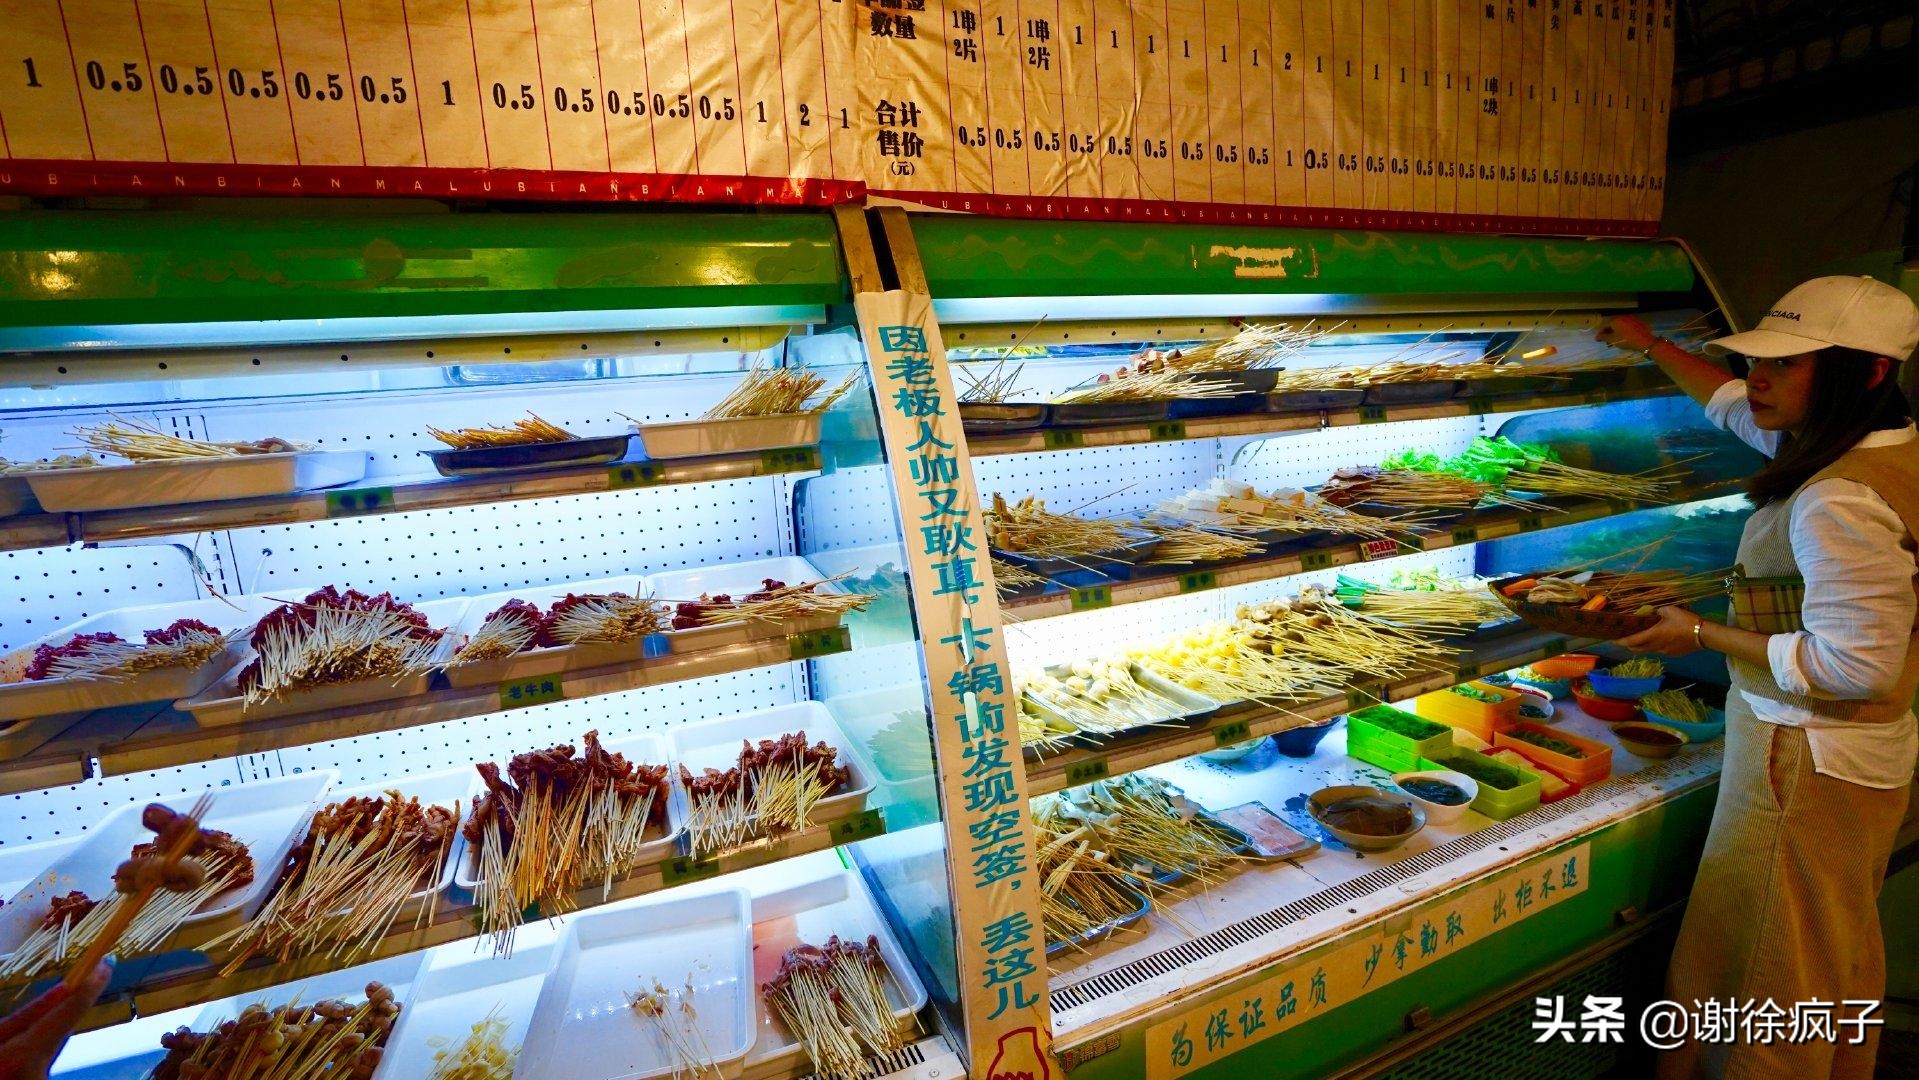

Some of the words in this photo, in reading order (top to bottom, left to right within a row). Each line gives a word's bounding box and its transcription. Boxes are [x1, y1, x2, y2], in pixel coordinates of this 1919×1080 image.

[870, 10, 917, 40] 数量
[952, 8, 977, 35] 1串
[996, 15, 1005, 37] 1
[1027, 17, 1051, 44] 1串
[1075, 25, 1083, 45] 1
[1111, 29, 1119, 49] 1
[1148, 34, 1155, 54] 1
[1183, 39, 1190, 58] 1
[1220, 45, 1228, 63] 1
[1251, 49, 1260, 67] 1
[1284, 52, 1292, 71] 2
[1315, 56, 1322, 73] 1
[1345, 60, 1352, 77] 1
[1373, 63, 1380, 80] 1
[1400, 67, 1407, 83] 1
[1423, 70, 1430, 87] 1
[1445, 73, 1452, 89] 1
[953, 37, 978, 64] 2片
[1028, 45, 1051, 72] 2片
[22, 57, 42, 88] 1
[86, 60, 143, 93] 0.5
[160, 64, 214, 96] 0.5
[228, 68, 279, 99] 0.5
[294, 71, 344, 103] 0.5
[360, 75, 407, 105] 0.5
[441, 79, 456, 106] 1
[492, 82, 535, 111] 0.5
[554, 86, 595, 113] 0.5
[607, 89, 646, 116] 0.5
[653, 93, 690, 119] 0.5
[699, 95, 735, 122] 0.5
[756, 100, 767, 123] 1
[798, 103, 810, 127] 2
[840, 107, 850, 129] 1
[875, 99, 922, 128] 合计
[876, 129, 924, 158] 售价
[958, 125, 987, 148] 0.5
[995, 128, 1023, 150] 0.5
[1033, 131, 1061, 152] 0.5
[1069, 133, 1095, 154] 0.5
[1108, 136, 1132, 157] 0.5
[1144, 138, 1167, 159] 0.5
[1181, 141, 1204, 161] 0.5
[1216, 144, 1238, 164] 0.5
[1248, 146, 1269, 166] 0.5
[1286, 150, 1293, 167] 1
[1303, 148, 1329, 170] 0.5
[1338, 153, 1358, 172] 0.5
[1366, 156, 1385, 174] 0.5
[1391, 157, 1409, 175] 0.5
[1416, 159, 1434, 177] 0.5
[1438, 161, 1455, 178] 0.5
[1458, 163, 1475, 180] 0.5
[1479, 165, 1495, 181] 0.5
[1500, 166, 1517, 183] 0.5
[1521, 168, 1537, 184] 0.5
[1543, 169, 1559, 185] 0.5
[1564, 170, 1579, 186] 0.5
[1582, 172, 1596, 188] 0.5
[1598, 173, 1613, 188] 0.5
[1614, 174, 1630, 189] 0.5
[1631, 175, 1646, 190] 0.5
[1649, 176, 1664, 191] 0.5
[507, 680, 554, 700] 老牛肉
[981, 911, 1040, 1021] 丢这儿
[1169, 966, 1329, 1068] 为保证品质
[1492, 855, 1580, 925] 出柜不退
